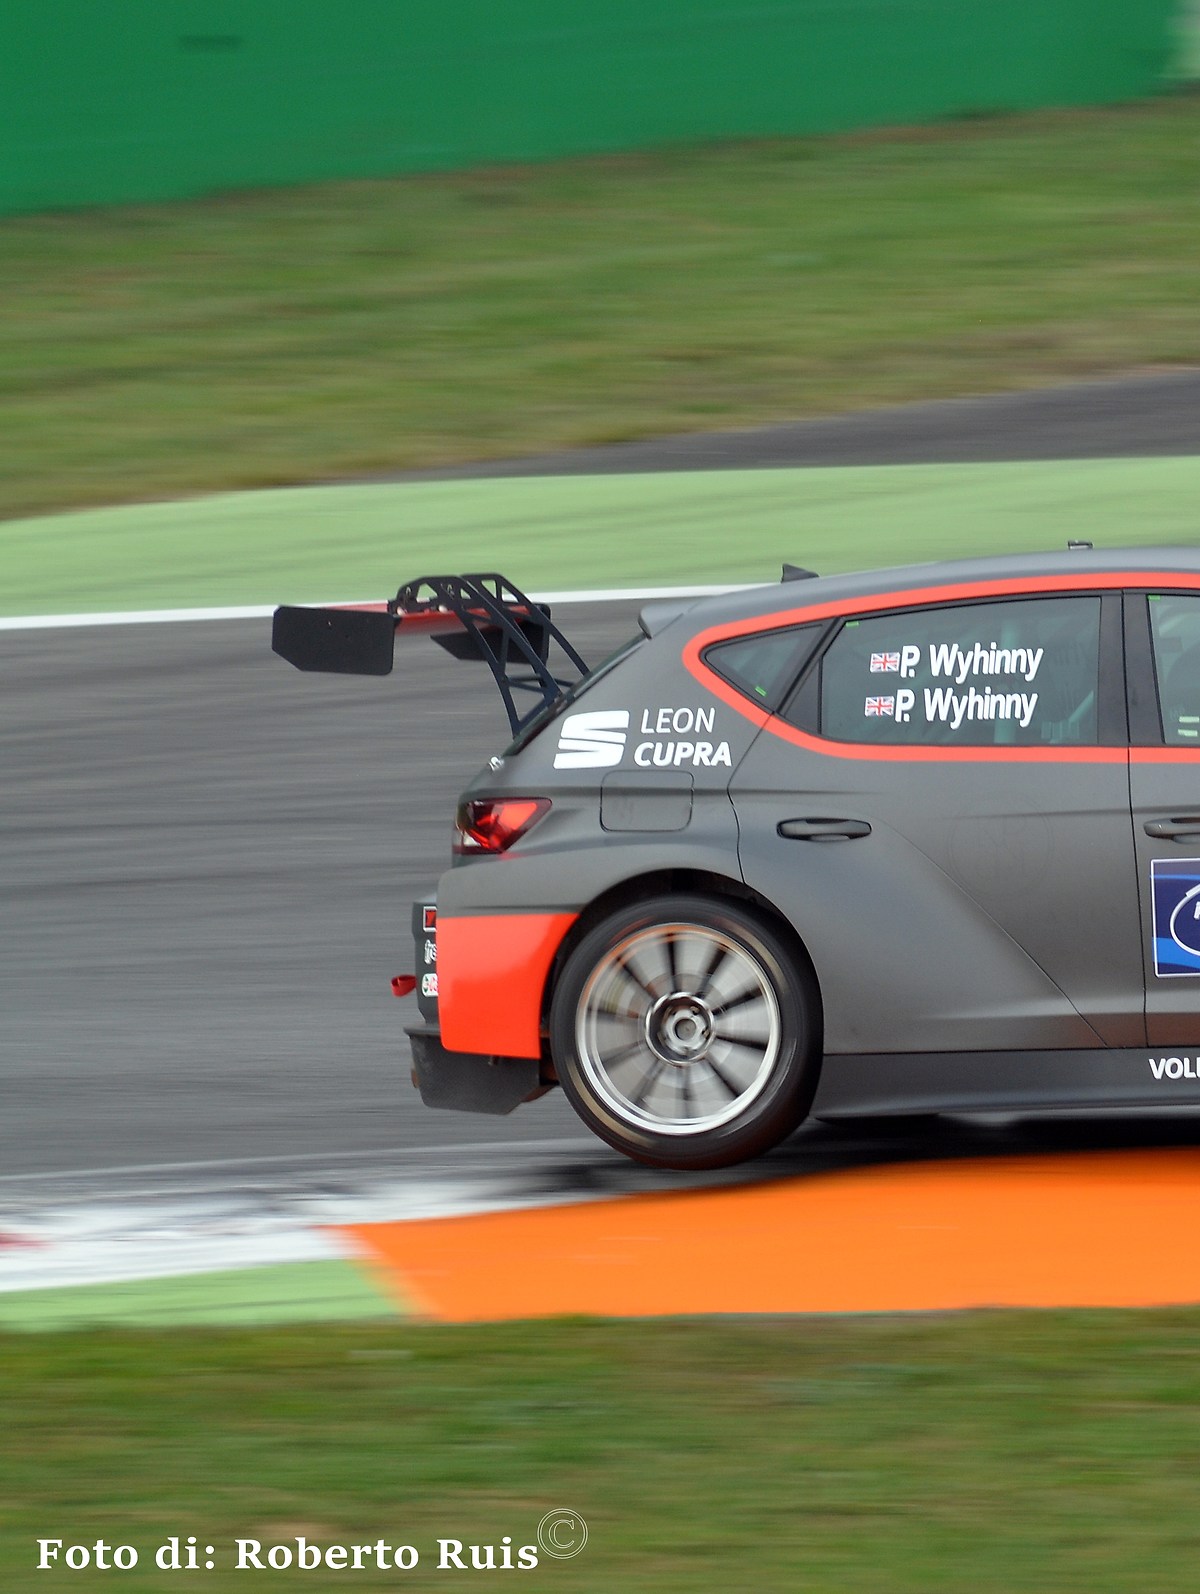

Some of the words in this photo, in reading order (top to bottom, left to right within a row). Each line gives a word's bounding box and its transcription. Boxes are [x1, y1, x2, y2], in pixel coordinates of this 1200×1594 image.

[900, 645, 921, 678] P.
[929, 641, 1044, 685] Wyhinny
[640, 707, 716, 734] LEON
[894, 689, 916, 722] P.
[923, 686, 1039, 730] Wyhinny
[633, 741, 732, 767] CUPRA
